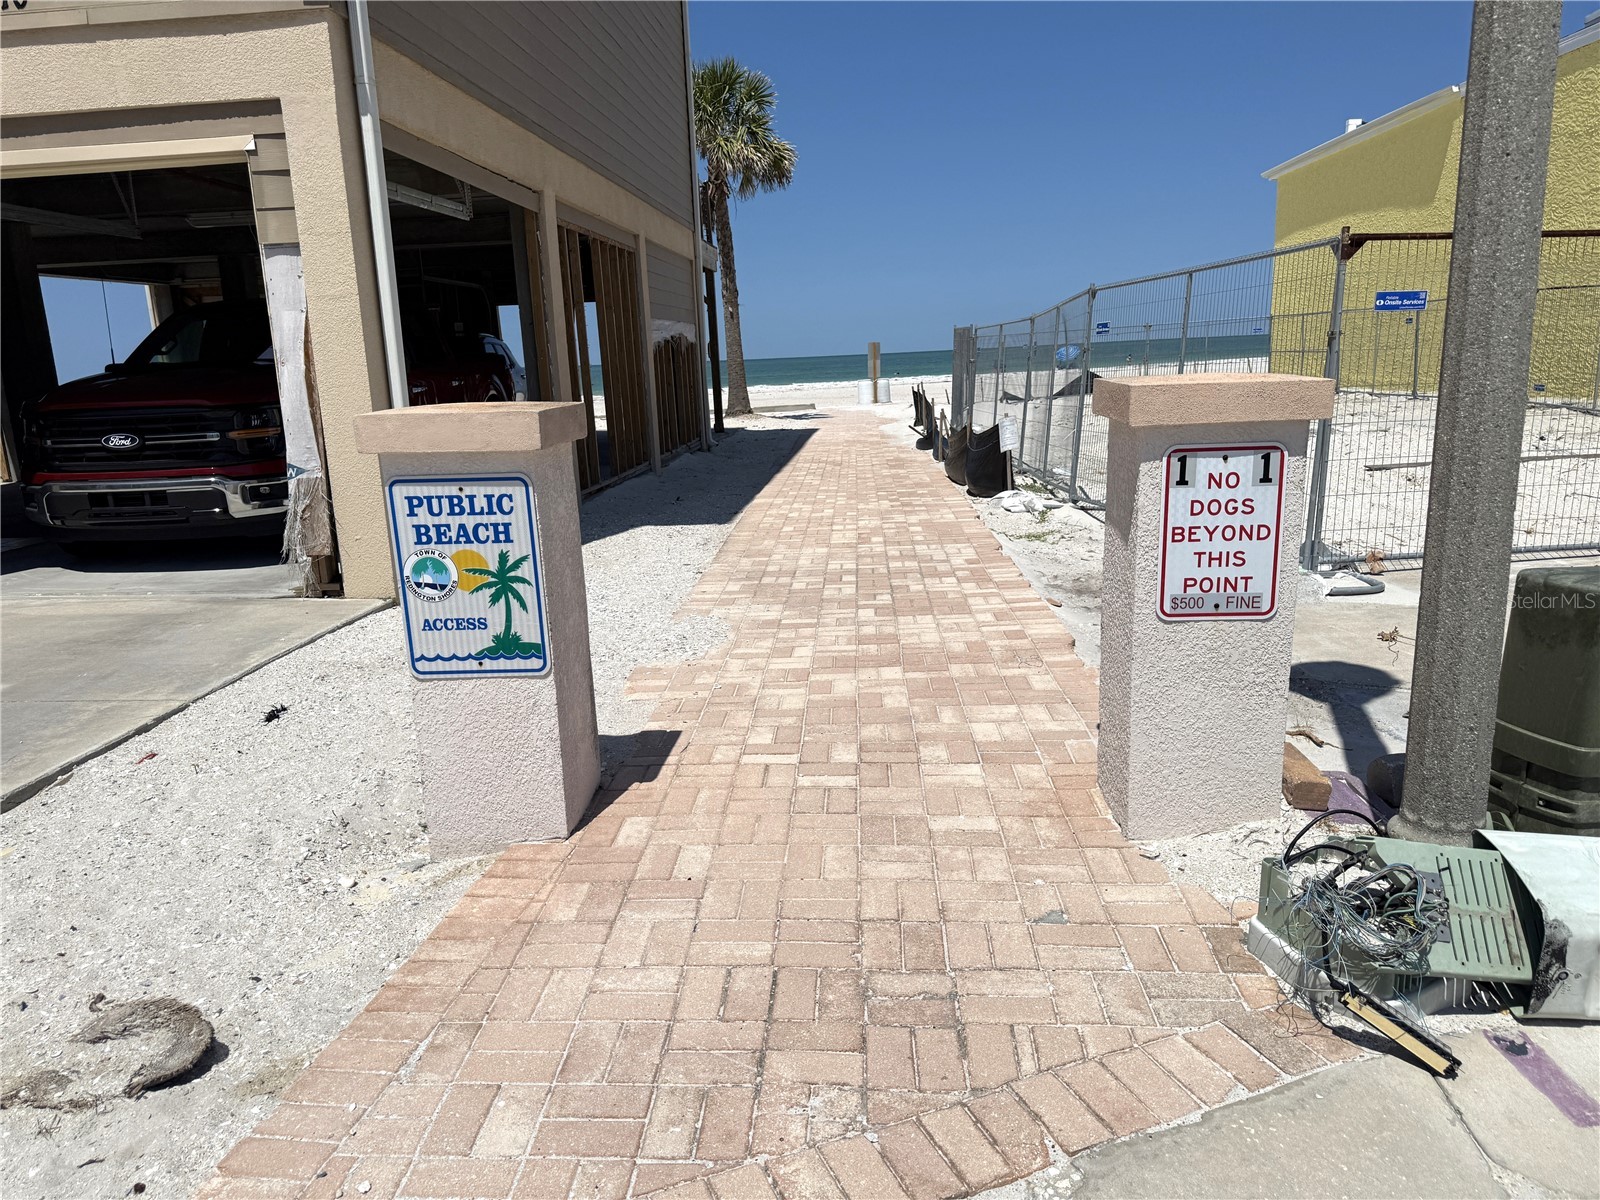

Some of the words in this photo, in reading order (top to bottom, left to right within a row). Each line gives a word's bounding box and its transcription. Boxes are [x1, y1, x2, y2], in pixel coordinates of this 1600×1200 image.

[108, 435, 132, 446] Ford
[1175, 454, 1189, 486] 1
[1259, 451, 1273, 484] 1
[1207, 471, 1241, 490] NO
[404, 493, 514, 517] PUBLIC
[1189, 498, 1255, 517] DOGS
[412, 522, 514, 546] BEACH
[1171, 524, 1271, 543] BEYOND
[414, 549, 436, 558] TOWN
[437, 552, 448, 560] OF
[1193, 550, 1247, 568] THIS
[404, 575, 436, 602] REDINGTON
[437, 580, 458, 602] SHORES
[1183, 576, 1254, 594] POINT
[1171, 596, 1205, 611] $500
[1225, 595, 1262, 609] FINE
[421, 617, 488, 632] ACCESS
